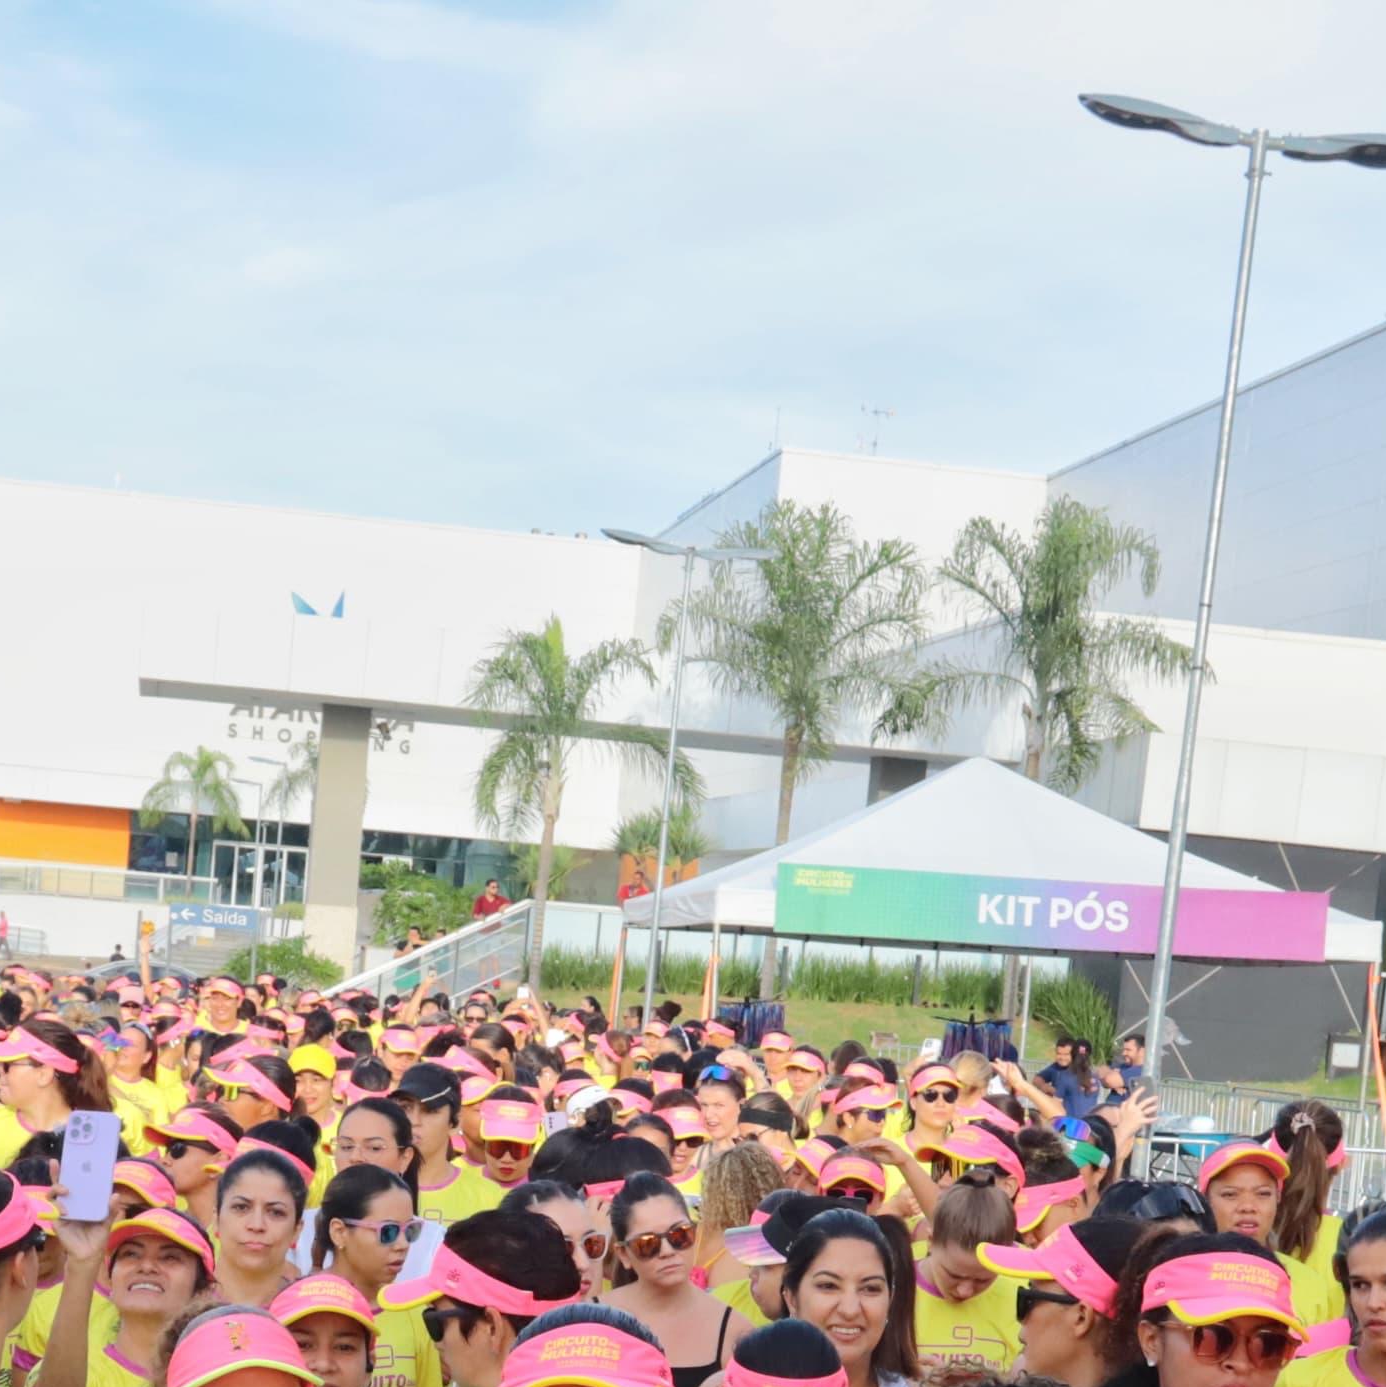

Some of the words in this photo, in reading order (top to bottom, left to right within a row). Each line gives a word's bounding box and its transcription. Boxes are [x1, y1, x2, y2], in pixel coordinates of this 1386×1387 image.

[977, 893, 1041, 927] KIT
[1048, 890, 1130, 932] PÓS
[544, 1335, 610, 1351] CIRCUITO
[541, 1346, 621, 1361] MULHERES
